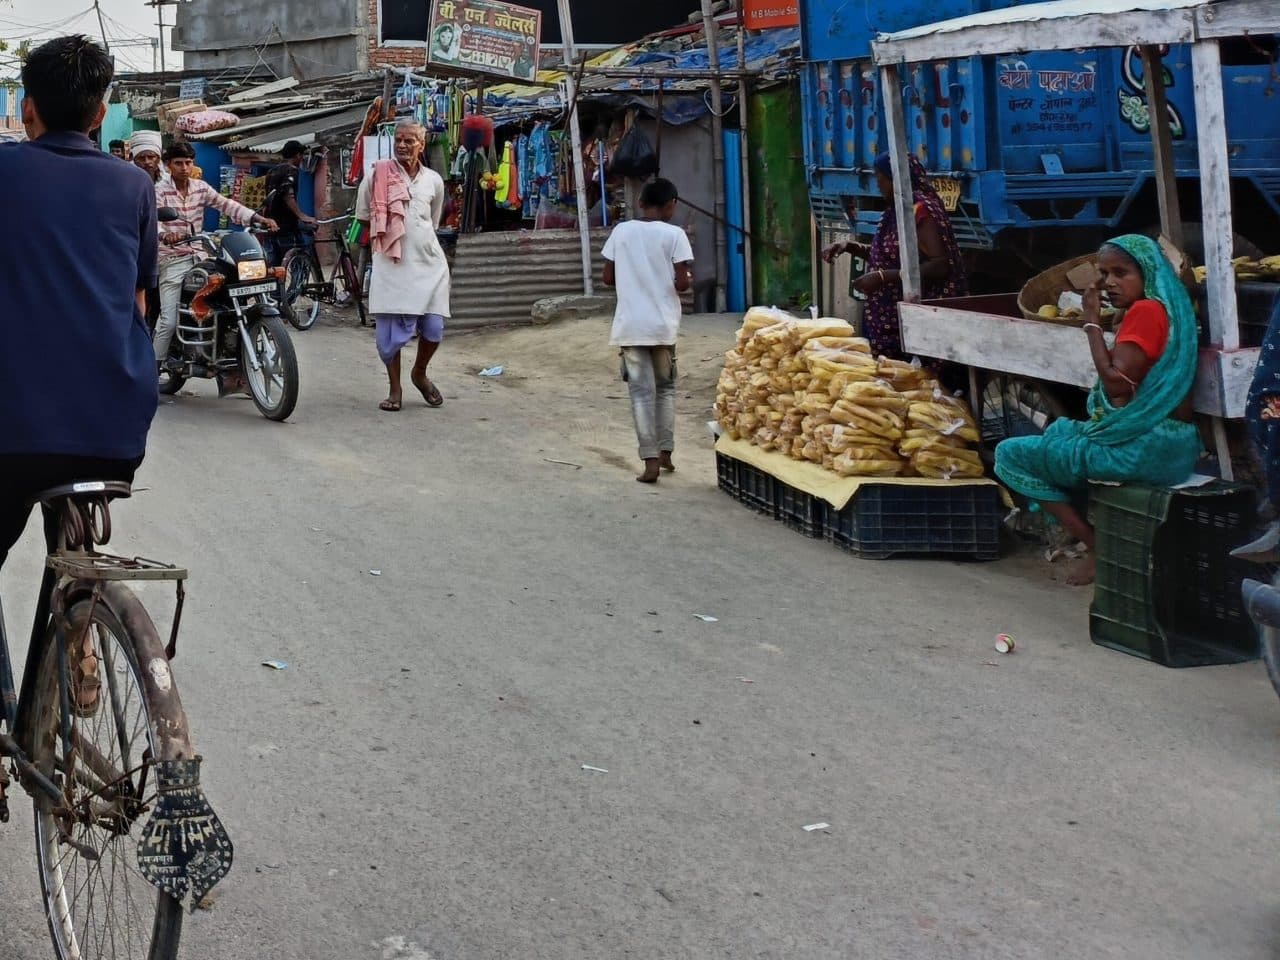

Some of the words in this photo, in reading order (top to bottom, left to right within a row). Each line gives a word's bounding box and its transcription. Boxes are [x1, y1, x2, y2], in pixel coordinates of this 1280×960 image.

[439, 0, 459, 20] बी.
[463, 7, 489, 25] एन.
[786, 6, 798, 16] Sto
[1000, 61, 1032, 89] बेटी
